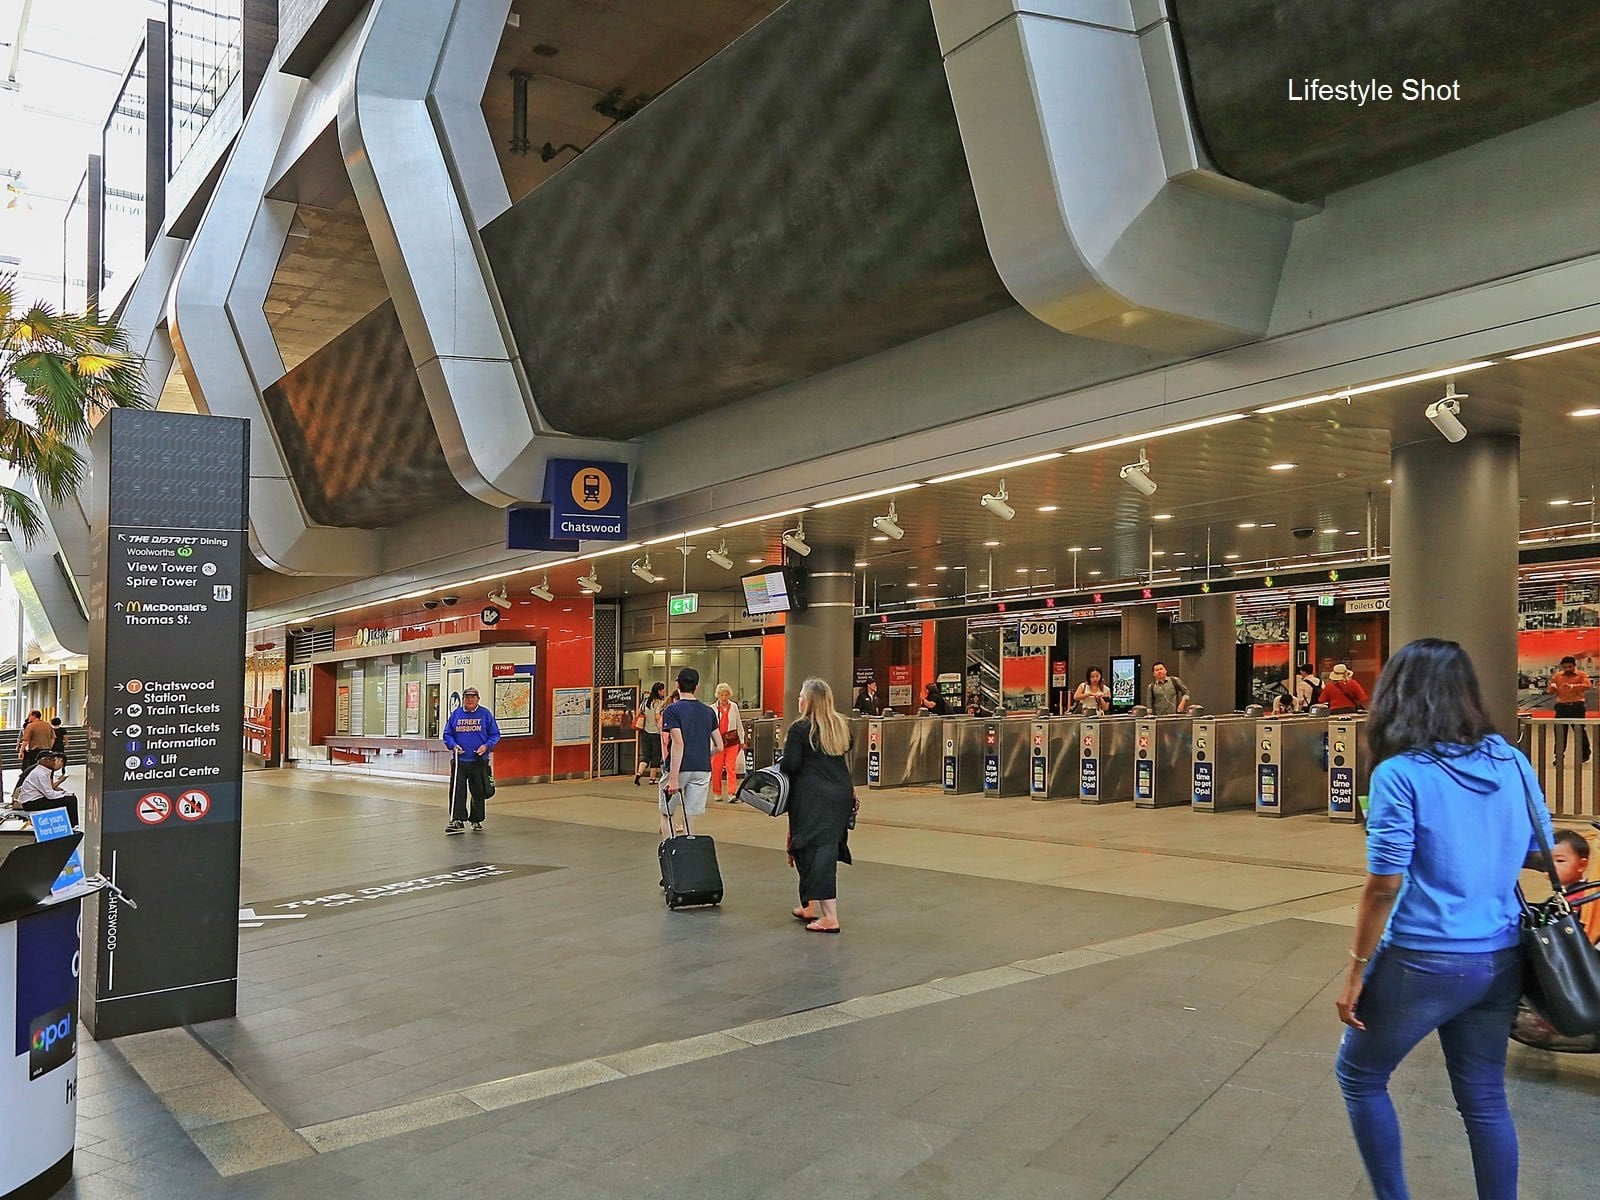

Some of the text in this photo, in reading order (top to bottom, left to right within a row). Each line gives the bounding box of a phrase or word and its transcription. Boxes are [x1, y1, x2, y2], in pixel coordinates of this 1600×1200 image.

[561, 522, 621, 533] Chatswood
[128, 535, 228, 546] THE DISTRICT Dining
[126, 548, 175, 557] Woolworths
[126, 562, 198, 573] View Tower
[126, 576, 198, 588] Spire Tower
[142, 603, 207, 612] McDonald's
[1349, 602, 1374, 610] Toilets
[125, 615, 191, 625] Thomas St.
[454, 655, 471, 665] Tickets
[144, 680, 215, 692] Chatswood
[144, 692, 186, 703] Station
[147, 703, 221, 716] Train Tickets
[457, 718, 481, 726] STREET
[147, 723, 221, 736] Train Tickets
[146, 737, 217, 750] Information
[161, 754, 178, 764] Lift
[123, 766, 220, 781] Medical Centre
[1332, 795, 1351, 804] Opal
[38, 815, 64, 826] Get yours
[40, 824, 68, 836] here today
[274, 864, 498, 908] THE DISTRICT
[32, 1012, 71, 1052] opal
